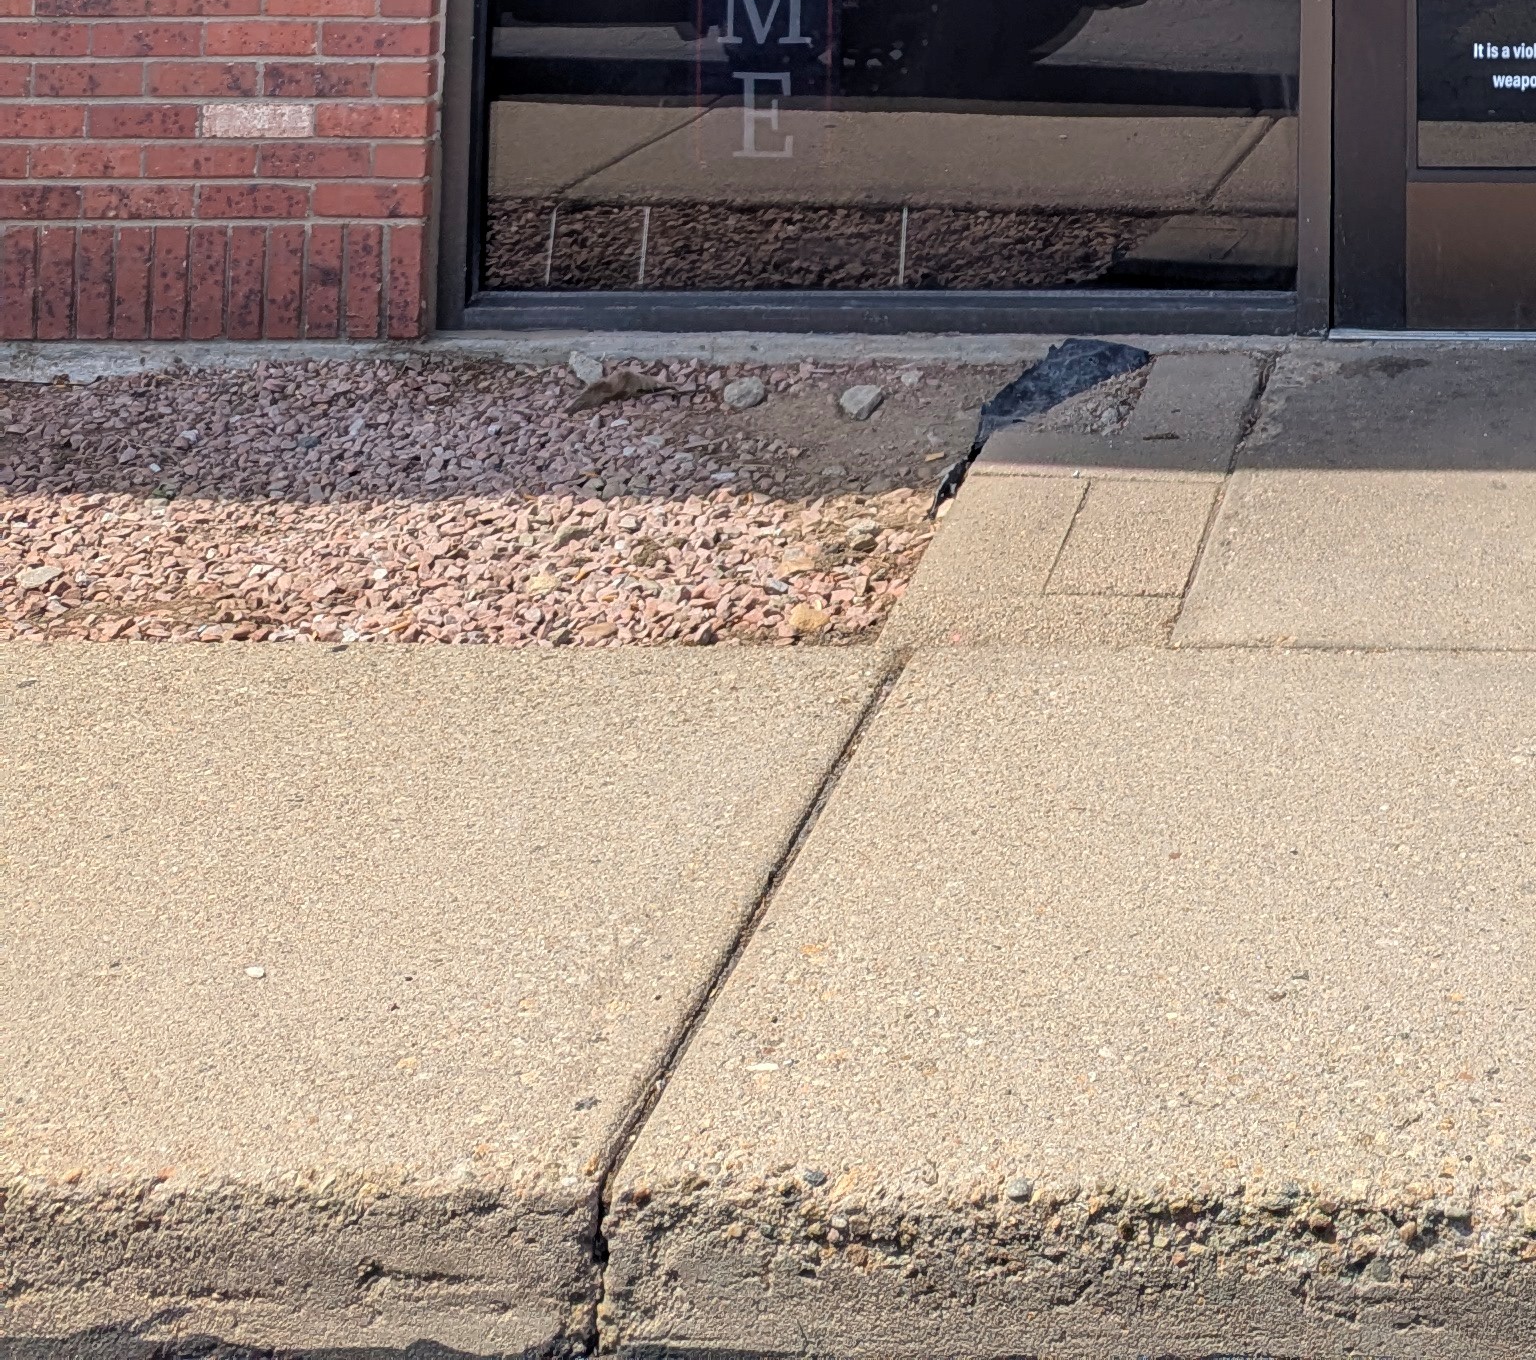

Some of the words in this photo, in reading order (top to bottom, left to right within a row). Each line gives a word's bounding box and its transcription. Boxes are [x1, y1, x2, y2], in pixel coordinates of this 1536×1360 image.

[1473, 42, 1484, 58] It
[1486, 42, 1499, 59] is
[1501, 45, 1511, 59] a
